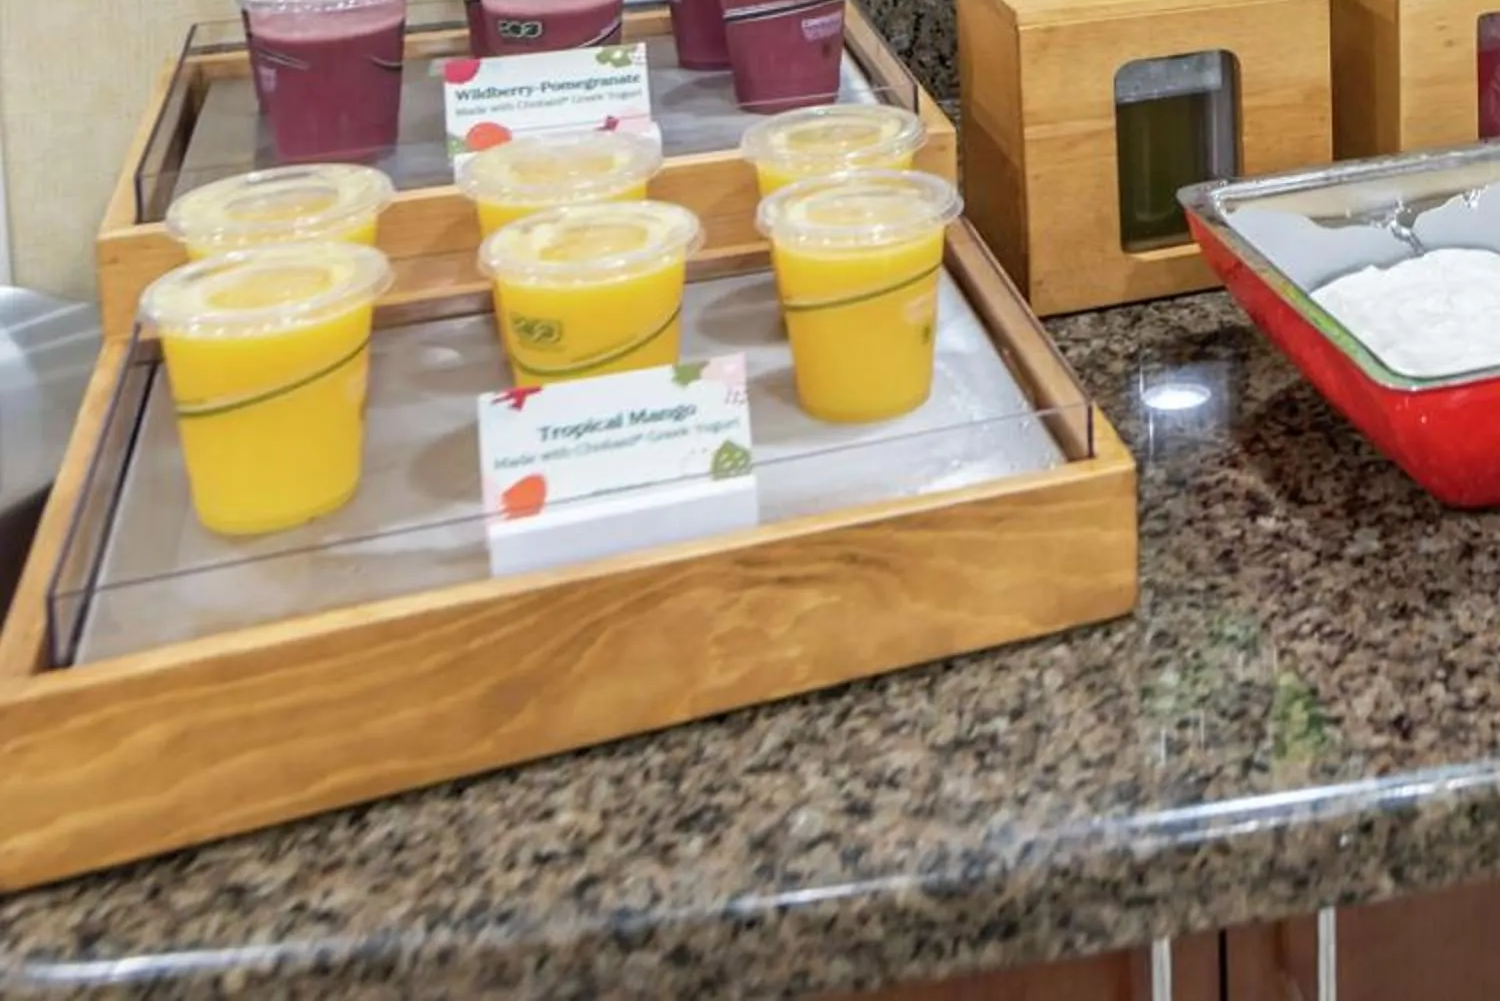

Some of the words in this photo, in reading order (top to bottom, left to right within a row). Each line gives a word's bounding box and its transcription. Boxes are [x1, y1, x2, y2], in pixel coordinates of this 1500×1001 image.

[455, 74, 640, 100] Wildberry-Pomegranate
[537, 413, 624, 442] Tropical
[629, 403, 697, 428] Mango
